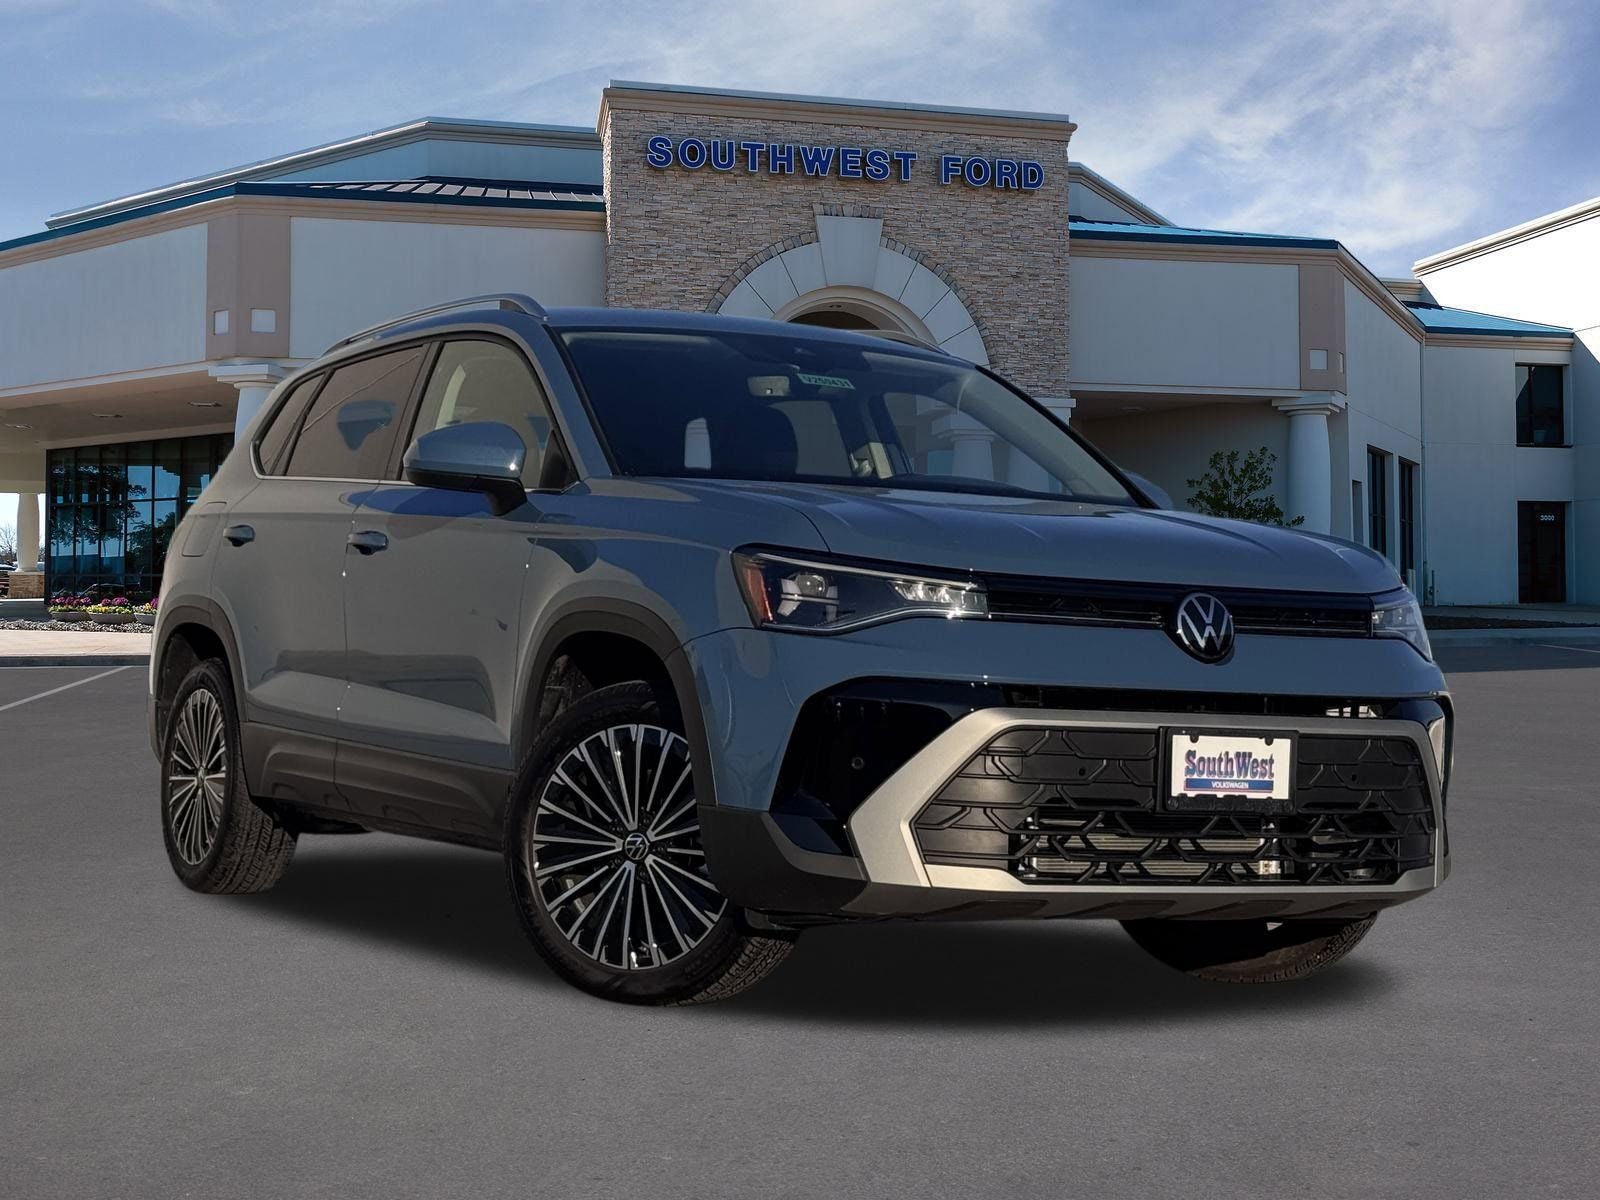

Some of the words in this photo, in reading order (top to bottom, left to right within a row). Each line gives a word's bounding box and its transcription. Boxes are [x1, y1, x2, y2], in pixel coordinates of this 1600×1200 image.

[647, 135, 917, 182] SOUTHWEST
[939, 154, 1045, 190] FORD
[1184, 749, 1275, 779] SouthWest
[1211, 780, 1249, 789] VOLKSWAGEN
